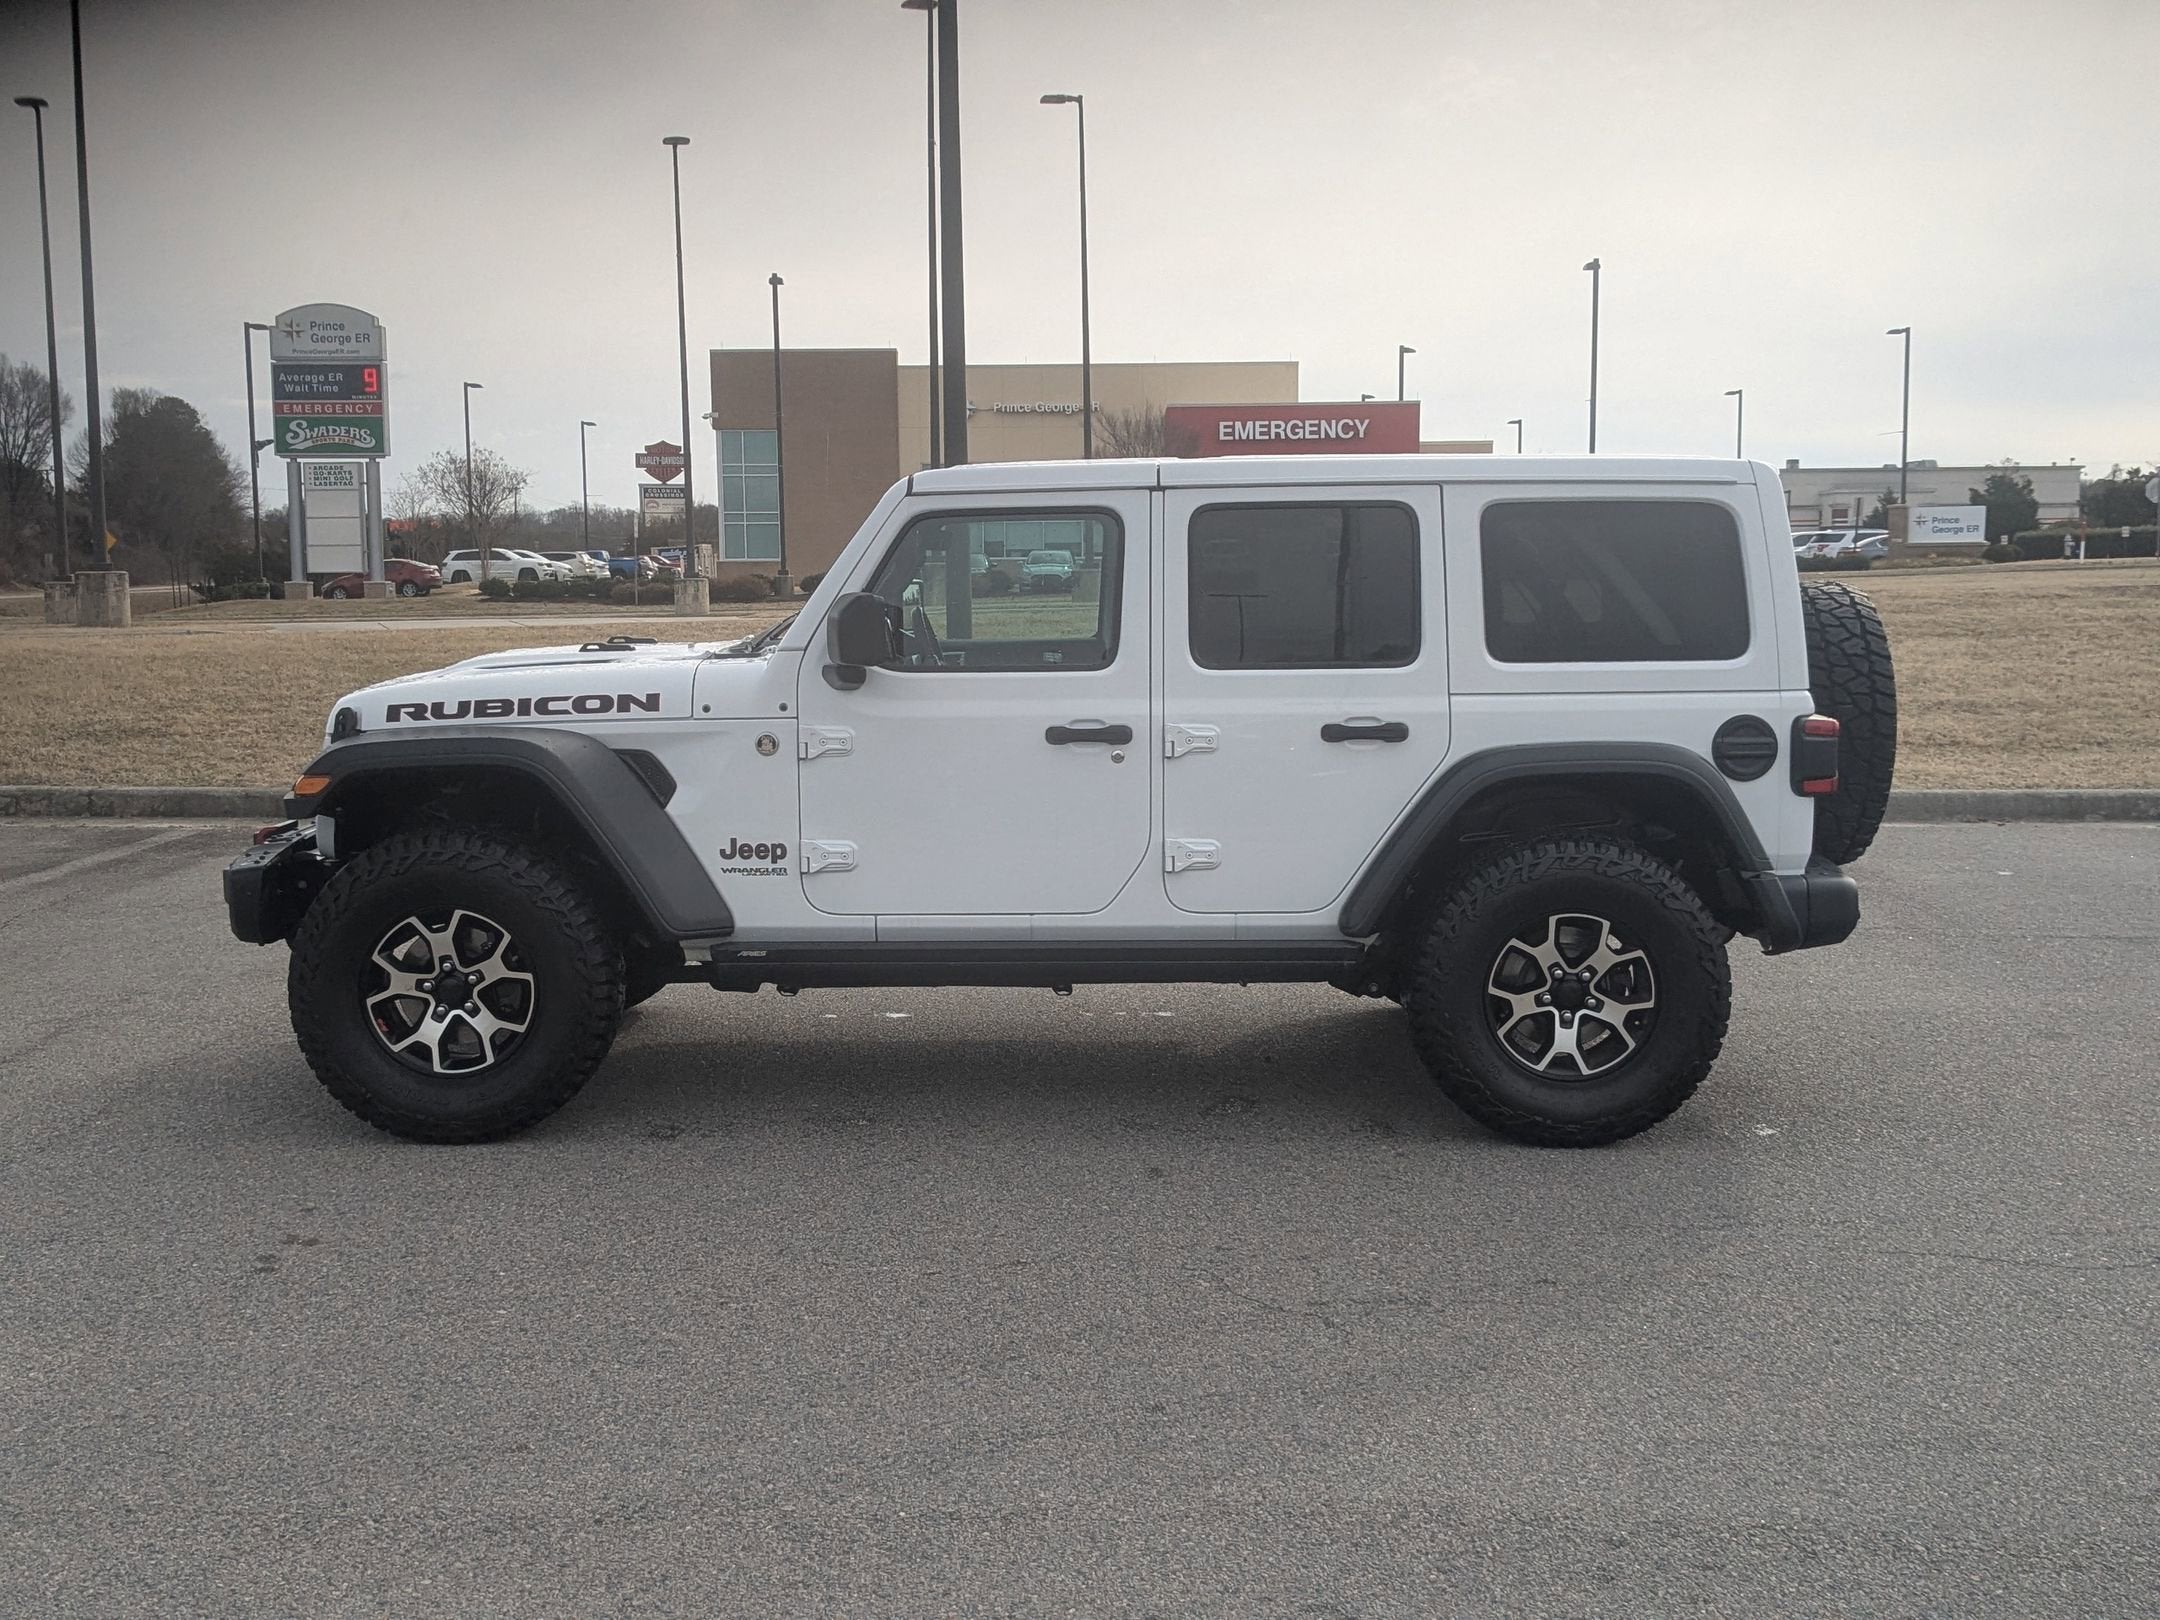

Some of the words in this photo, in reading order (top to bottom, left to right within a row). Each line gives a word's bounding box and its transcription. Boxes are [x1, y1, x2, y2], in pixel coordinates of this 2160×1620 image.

[310, 321, 345, 331] Prince
[310, 333, 352, 345] George
[355, 333, 370, 343] ER
[279, 373, 325, 383] Average
[328, 373, 343, 381] ER
[363, 368, 377, 393] 9
[284, 384, 309, 392] Wait
[312, 384, 339, 392] Time
[283, 404, 373, 413] EMERGENCY
[993, 402, 1031, 412] Prince
[1035, 401, 1080, 414] George
[286, 420, 373, 444] SWADERS
[1219, 419, 1370, 441] EMERGENCY
[639, 456, 685, 465] HARLEY-DAVIDSO
[1931, 525, 1964, 535] George
[1966, 525, 1979, 533] ER
[385, 693, 661, 723] RUBICON
[720, 837, 787, 864] Jeep
